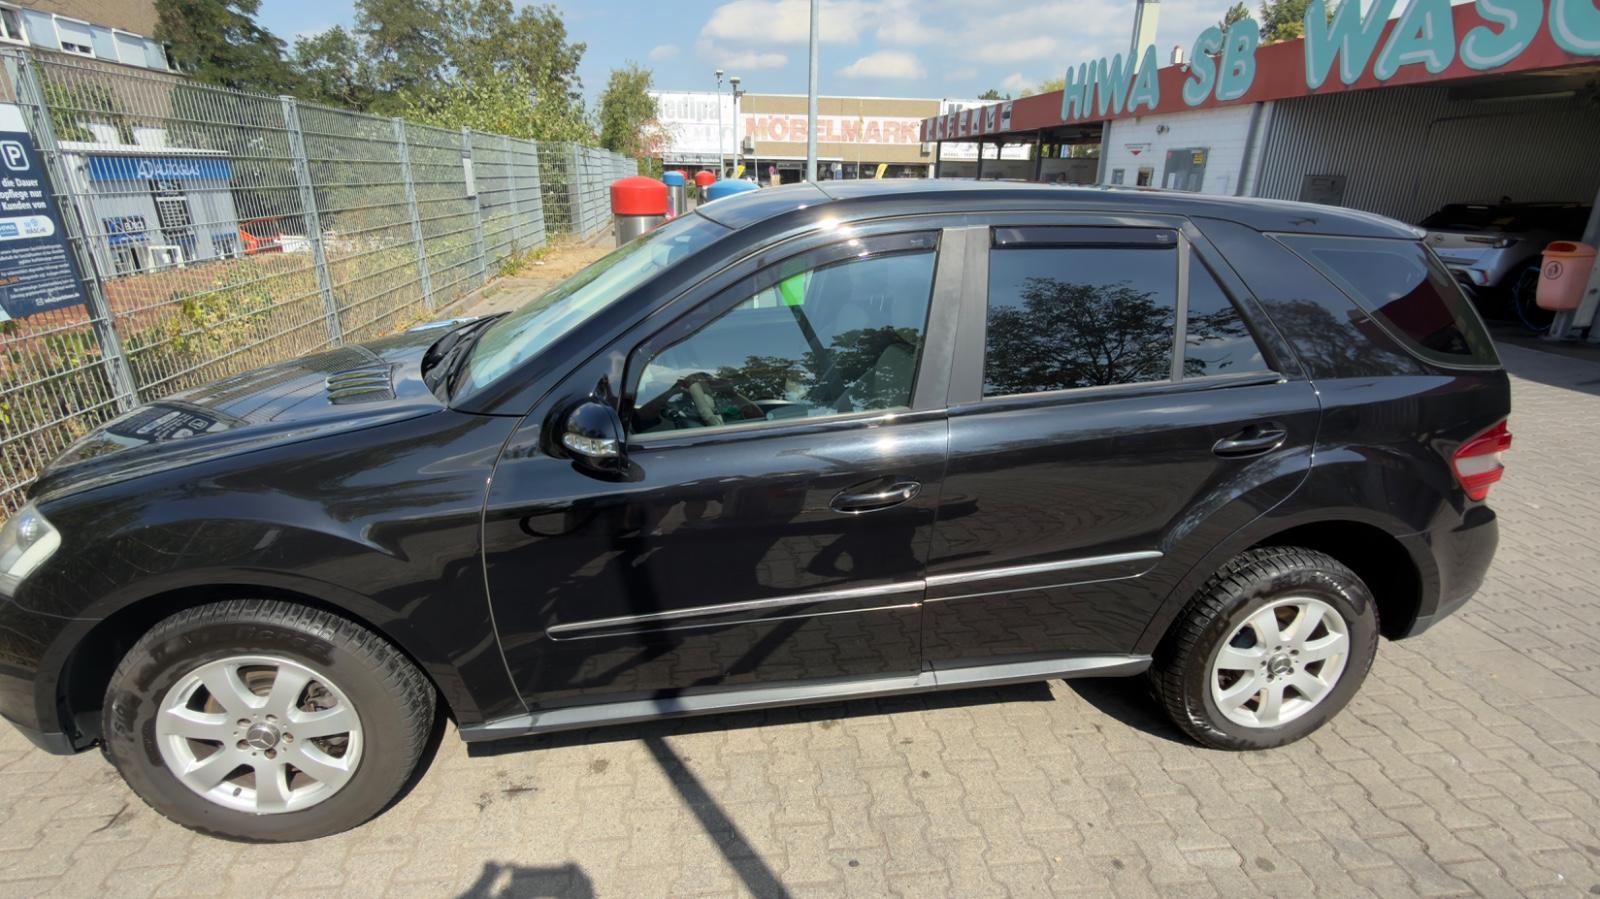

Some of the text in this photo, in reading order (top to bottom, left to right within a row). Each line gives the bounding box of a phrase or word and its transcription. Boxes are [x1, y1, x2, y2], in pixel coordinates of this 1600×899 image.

[1061, 44, 1160, 121] HIWA
[1183, 18, 1258, 107] SB
[656, 97, 719, 121] edipa
[1, 177, 38, 187] die Dauer
[29, 190, 42, 198] nur
[1, 200, 47, 211] Kunden von
